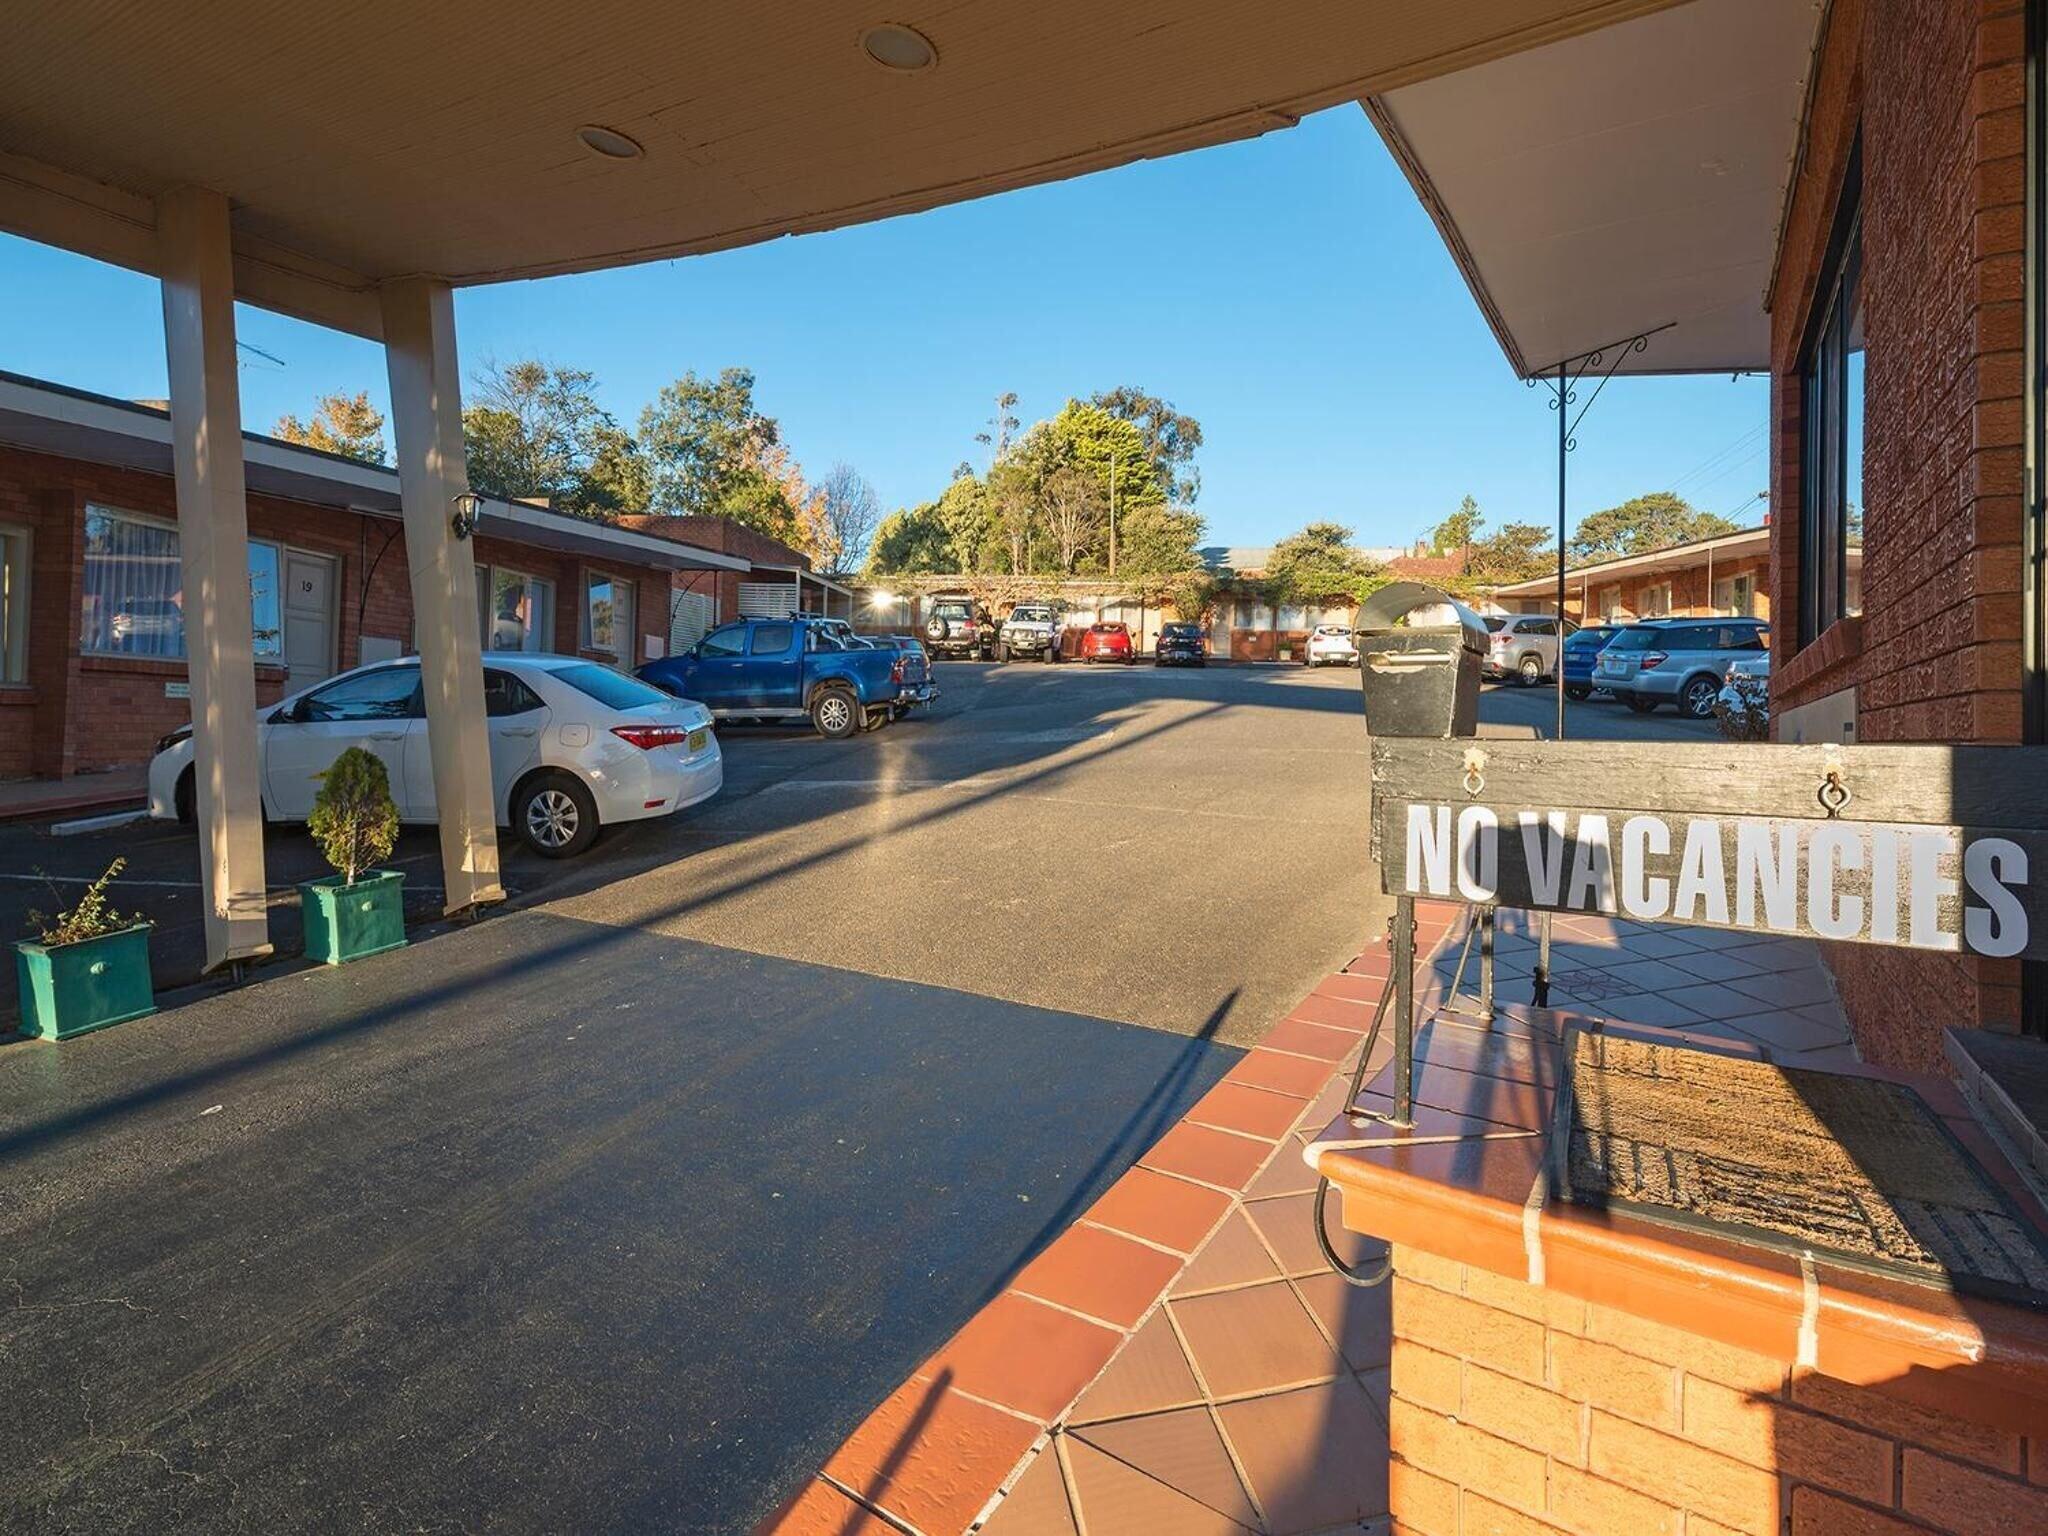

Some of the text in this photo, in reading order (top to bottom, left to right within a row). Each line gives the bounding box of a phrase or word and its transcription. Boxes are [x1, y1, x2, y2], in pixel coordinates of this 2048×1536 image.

[302, 580, 313, 592] 19
[1406, 804, 2028, 957] NO VACANCIES
